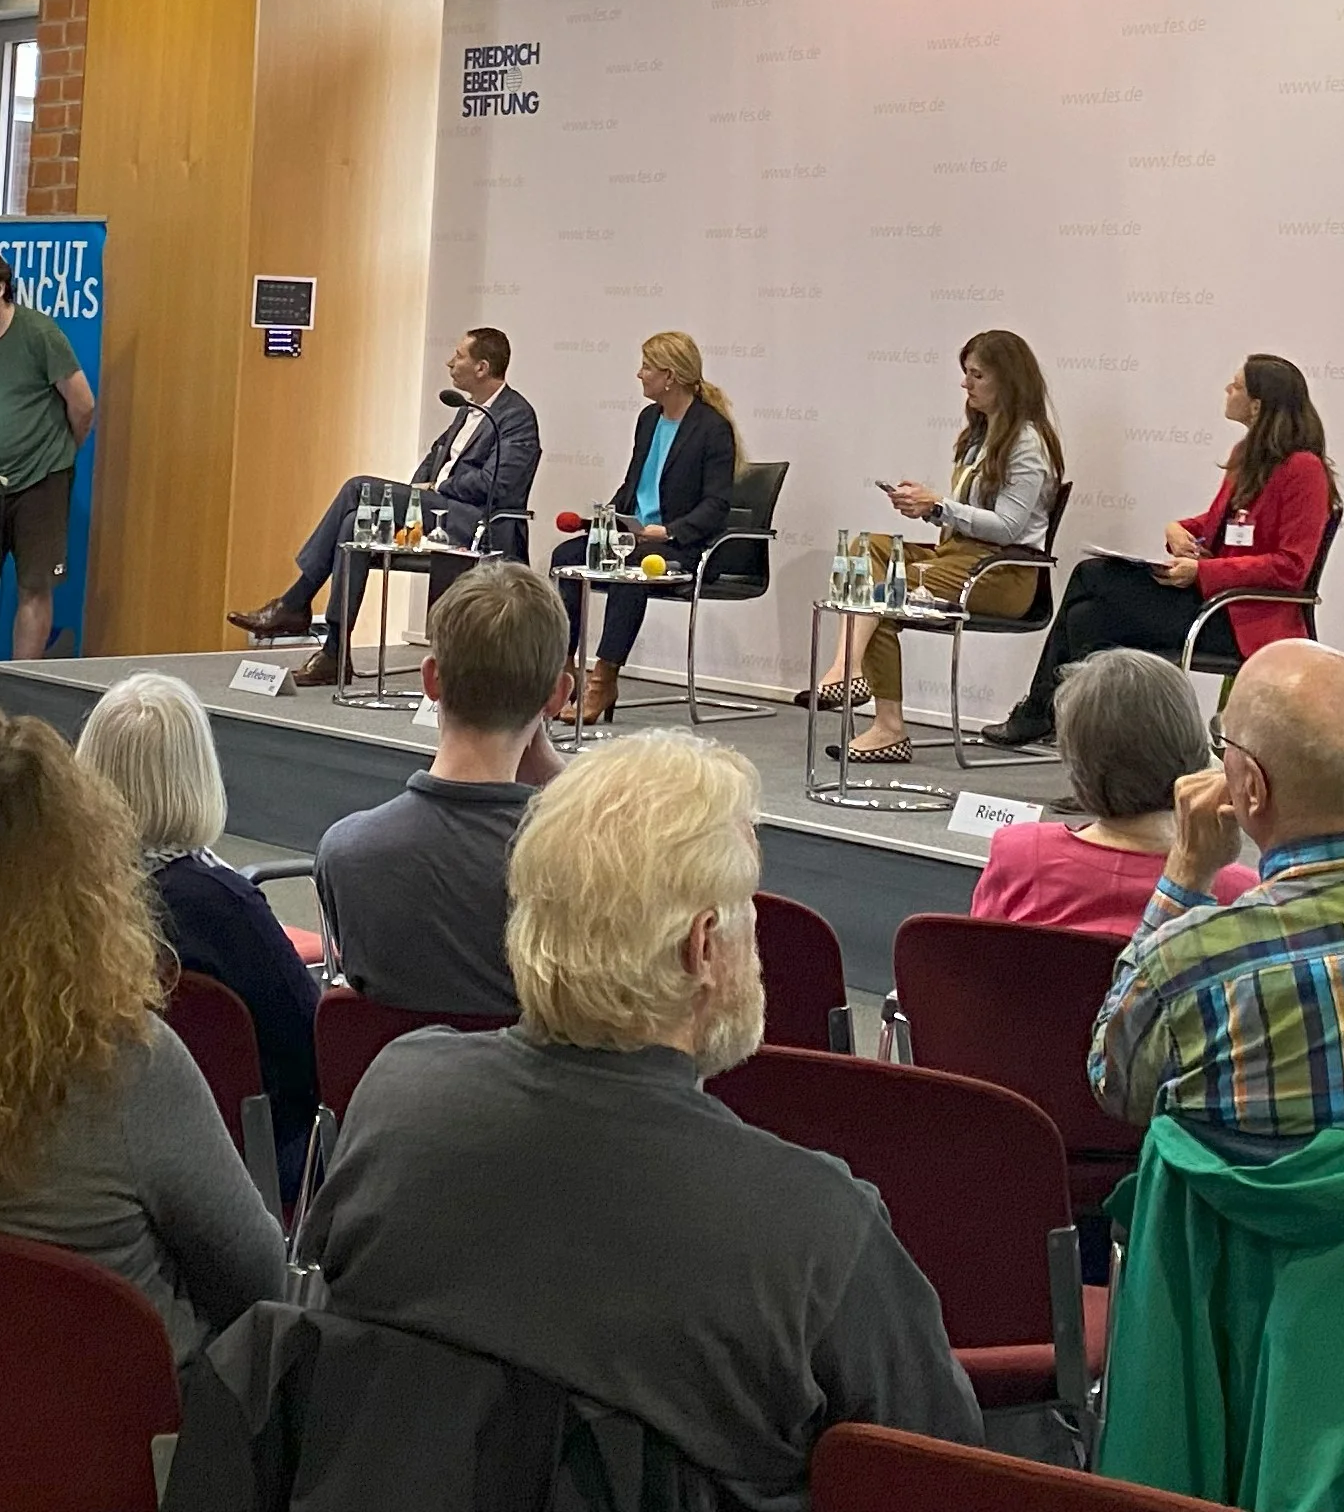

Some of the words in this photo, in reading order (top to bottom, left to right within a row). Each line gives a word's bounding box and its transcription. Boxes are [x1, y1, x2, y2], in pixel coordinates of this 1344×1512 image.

[464, 42, 541, 70] FRIEDRICH
[463, 71, 508, 93] EBERT
[461, 91, 540, 117] STIFTUNG
[933, 158, 1007, 175] www.fes.de
[1128, 151, 1216, 168] www.fes.de
[1059, 221, 1141, 236] www.fes.de
[1126, 289, 1214, 305] www.fes.de
[1124, 427, 1212, 446] www.fes.de
[976, 804, 1015, 827] Rietig
